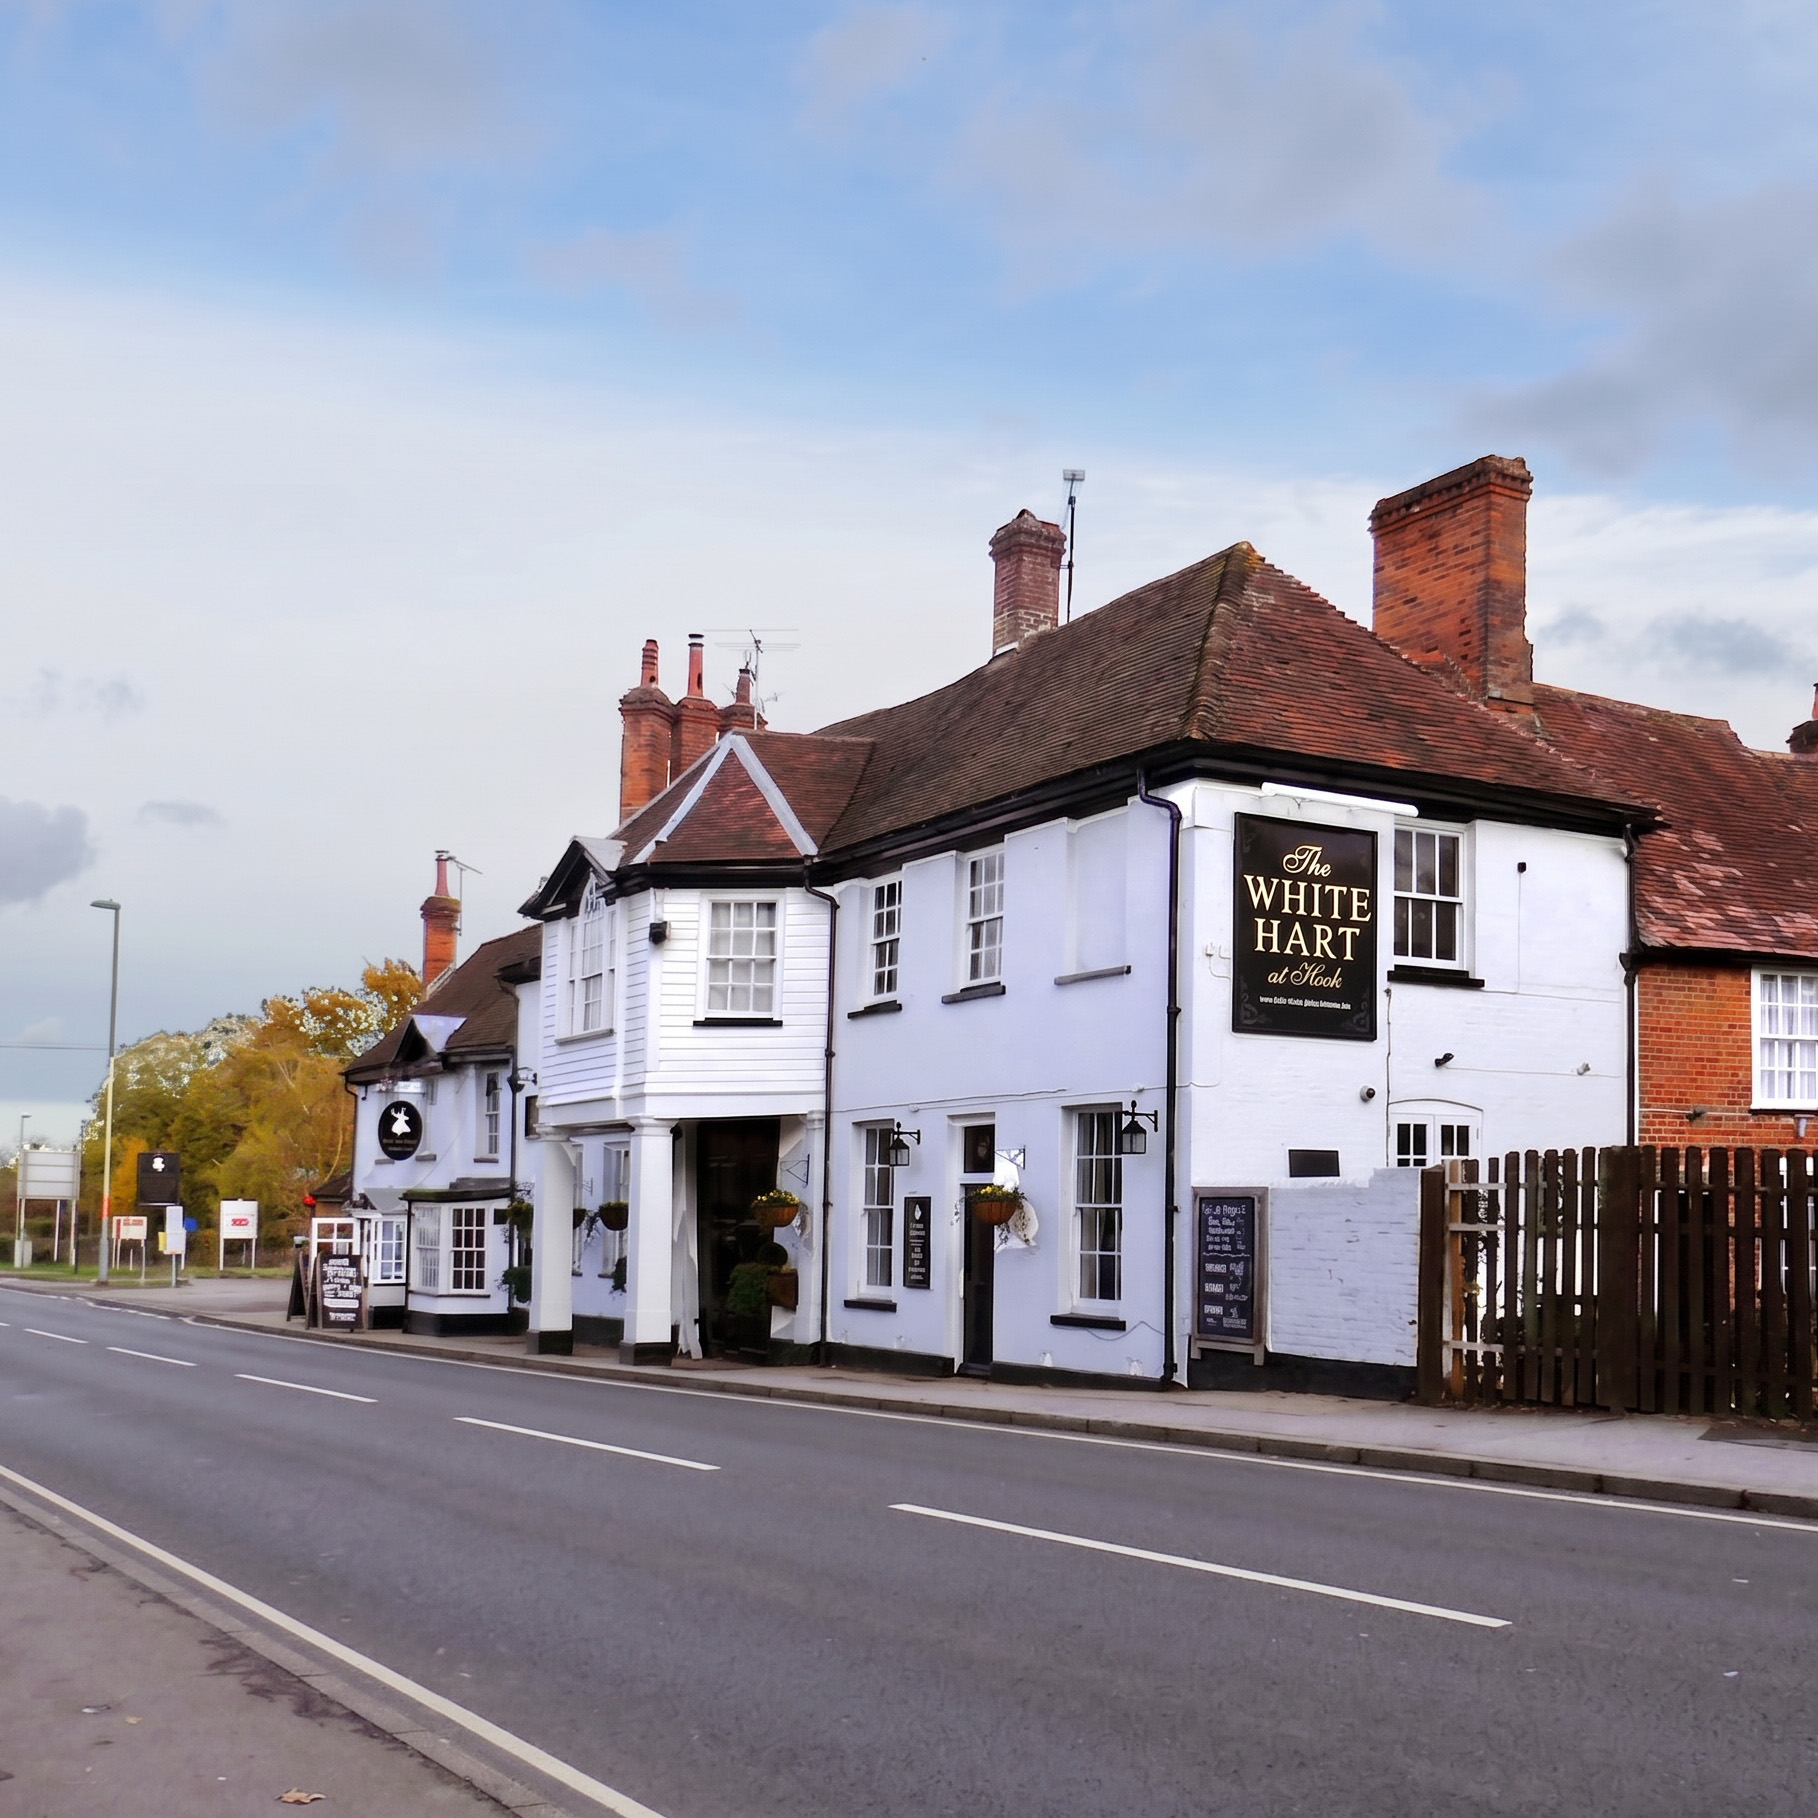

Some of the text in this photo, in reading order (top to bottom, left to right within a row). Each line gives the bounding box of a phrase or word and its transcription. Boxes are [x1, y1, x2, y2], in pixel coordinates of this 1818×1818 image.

[1282, 845, 1332, 878] The
[1243, 874, 1372, 921] WHITE
[1254, 917, 1361, 961] HART
[1267, 962, 1342, 988] at Hook
